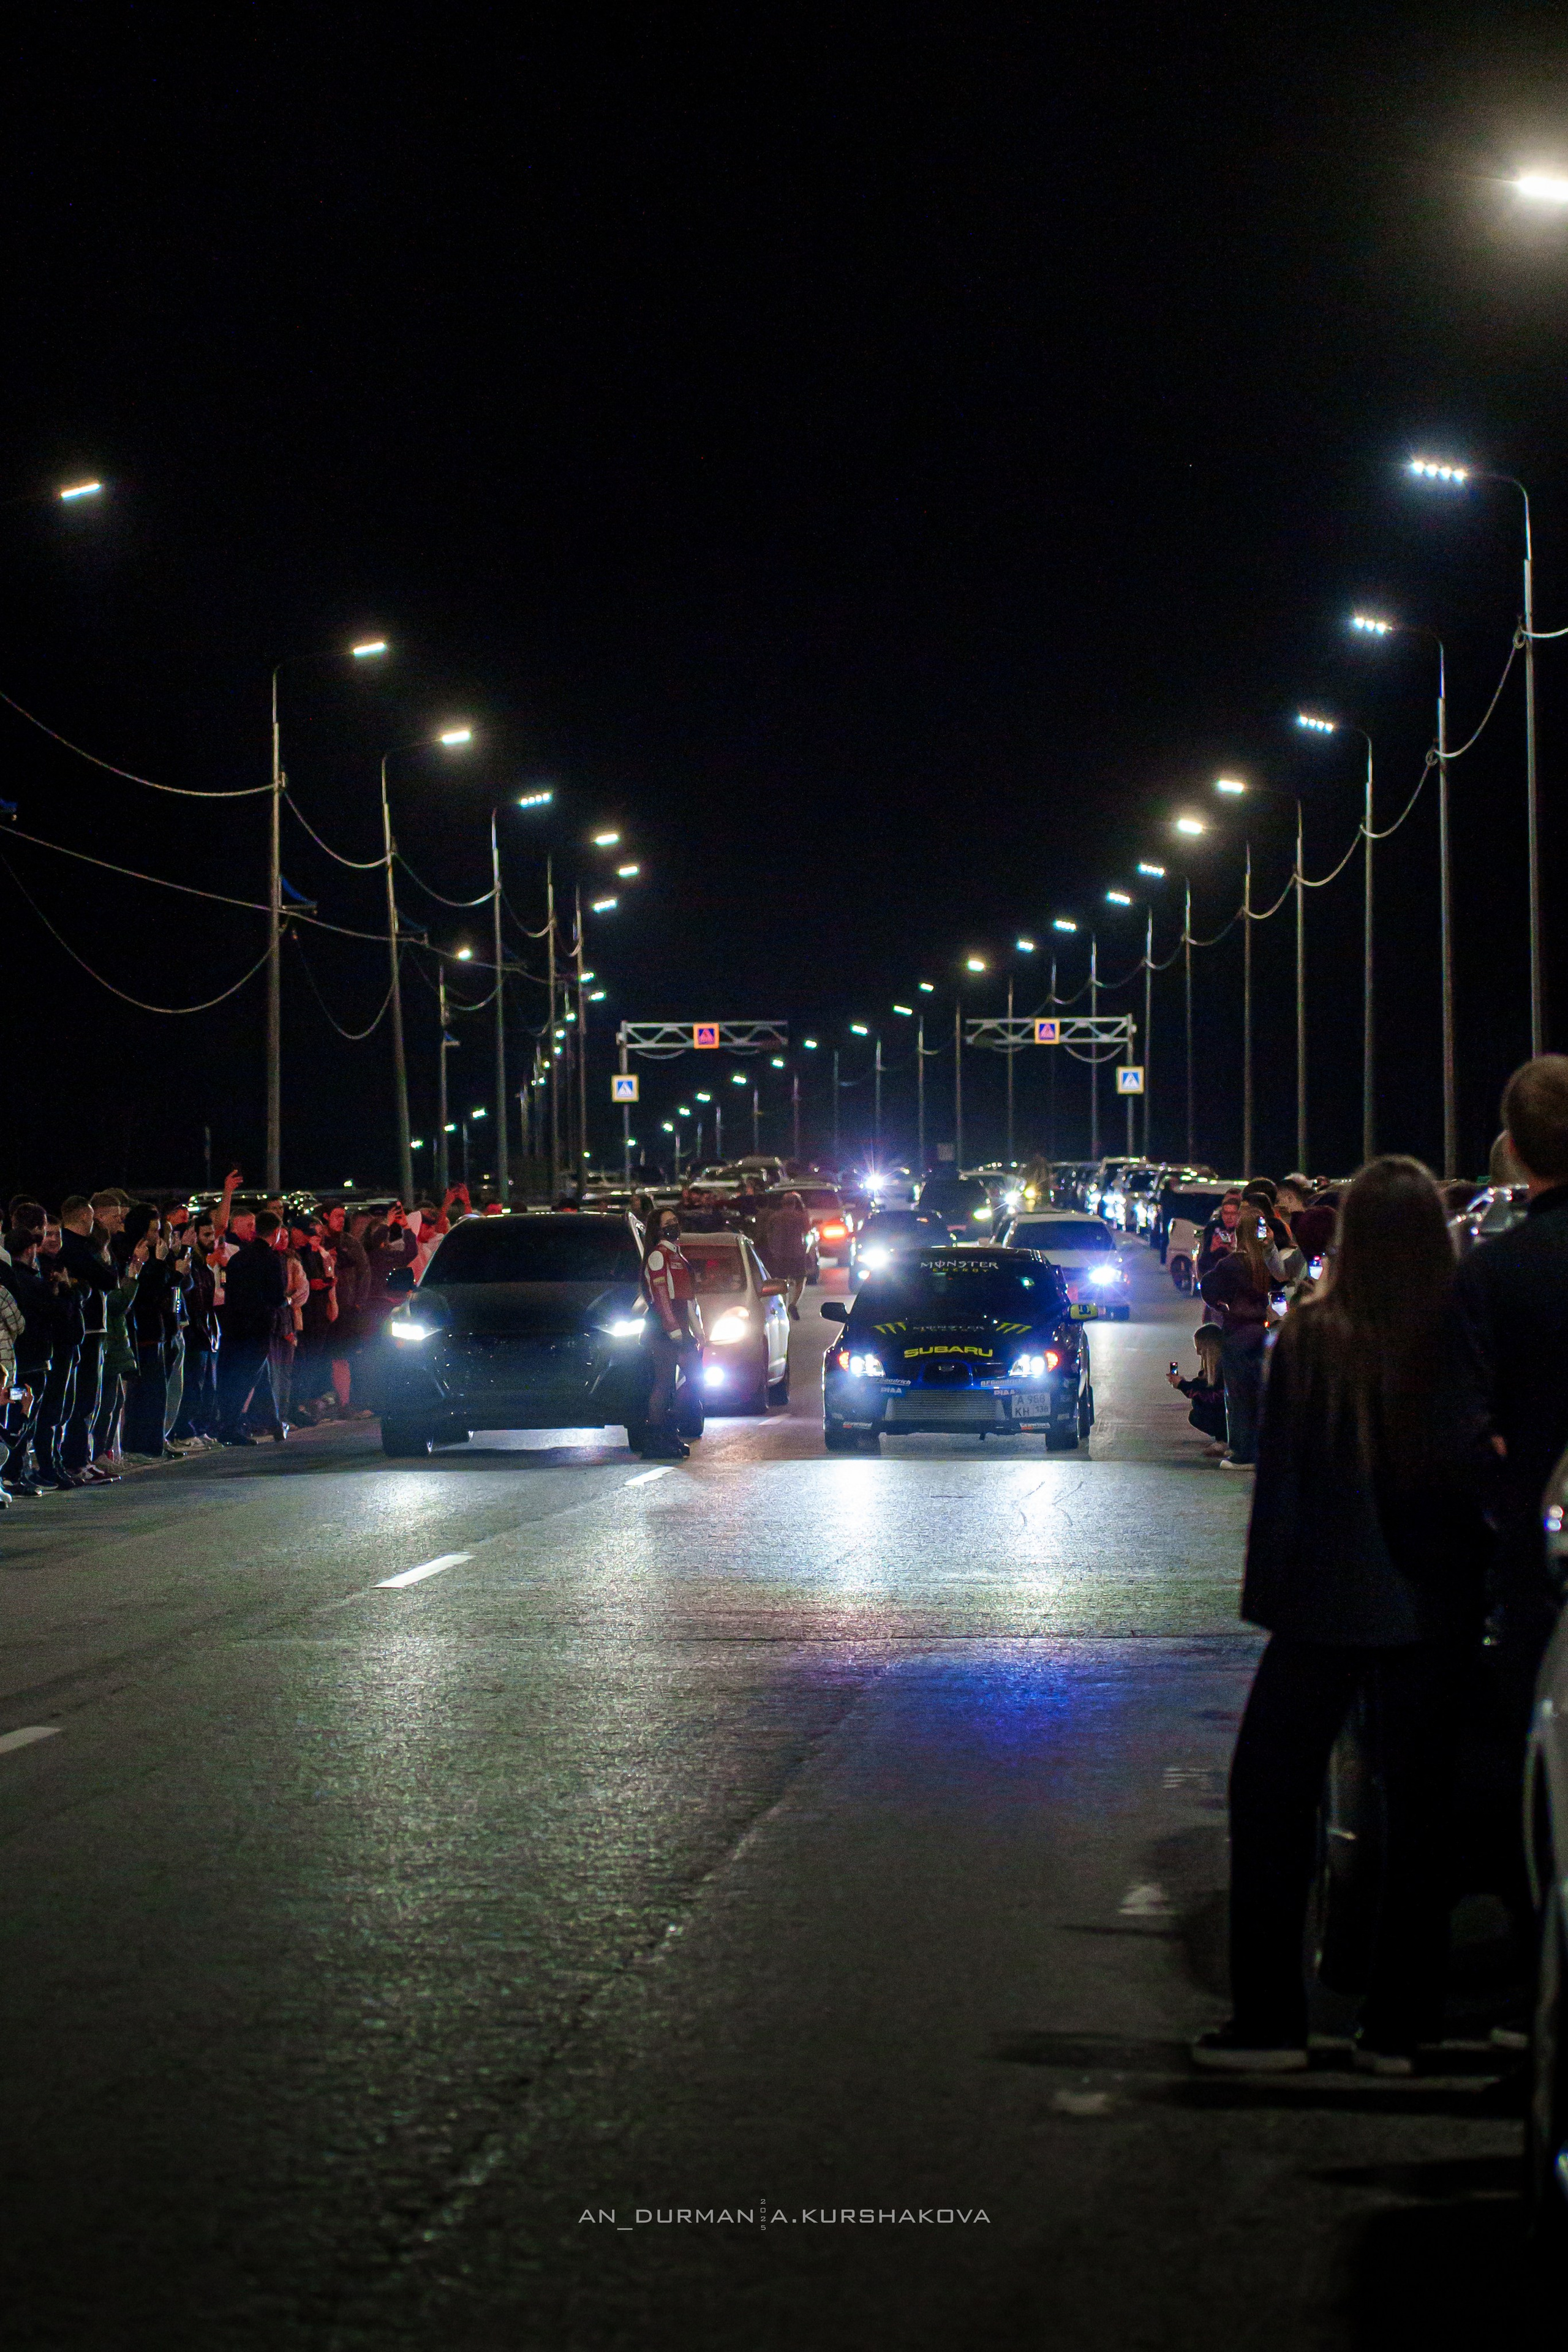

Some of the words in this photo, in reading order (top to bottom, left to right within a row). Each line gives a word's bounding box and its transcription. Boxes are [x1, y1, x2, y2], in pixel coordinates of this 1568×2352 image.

[920, 1260, 998, 1270] MONSTER
[903, 1346, 993, 1359] SUBARU
[1017, 1395, 1024, 1404] A
[1015, 1407, 1030, 1417] KH
